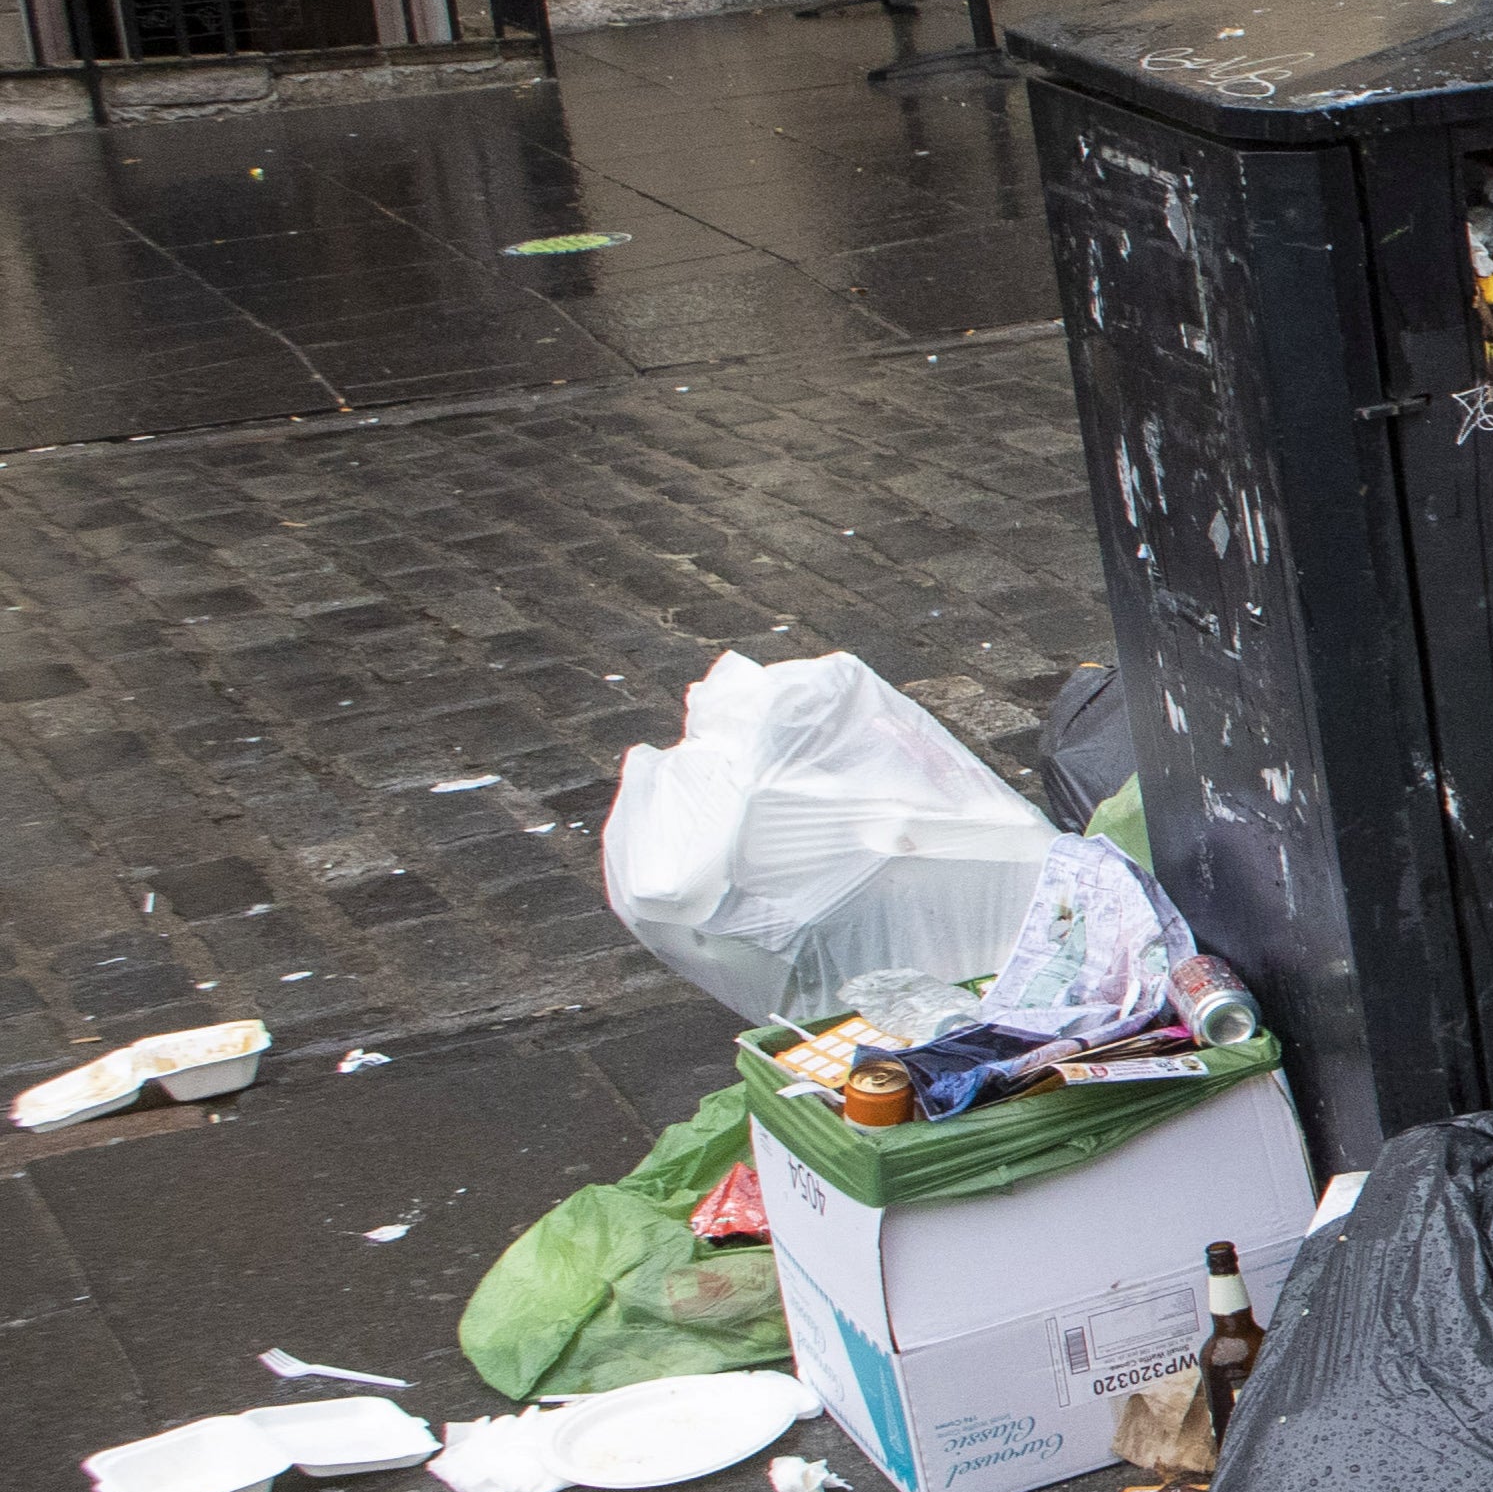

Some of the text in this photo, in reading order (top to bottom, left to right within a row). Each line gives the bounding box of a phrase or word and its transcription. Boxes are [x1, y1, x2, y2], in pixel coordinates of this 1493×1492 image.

[788, 1154, 827, 1217] 4054
[1093, 1352, 1200, 1396] WP320320
[943, 1415, 1036, 1456] Classic
[945, 1432, 1064, 1489] Carousel
